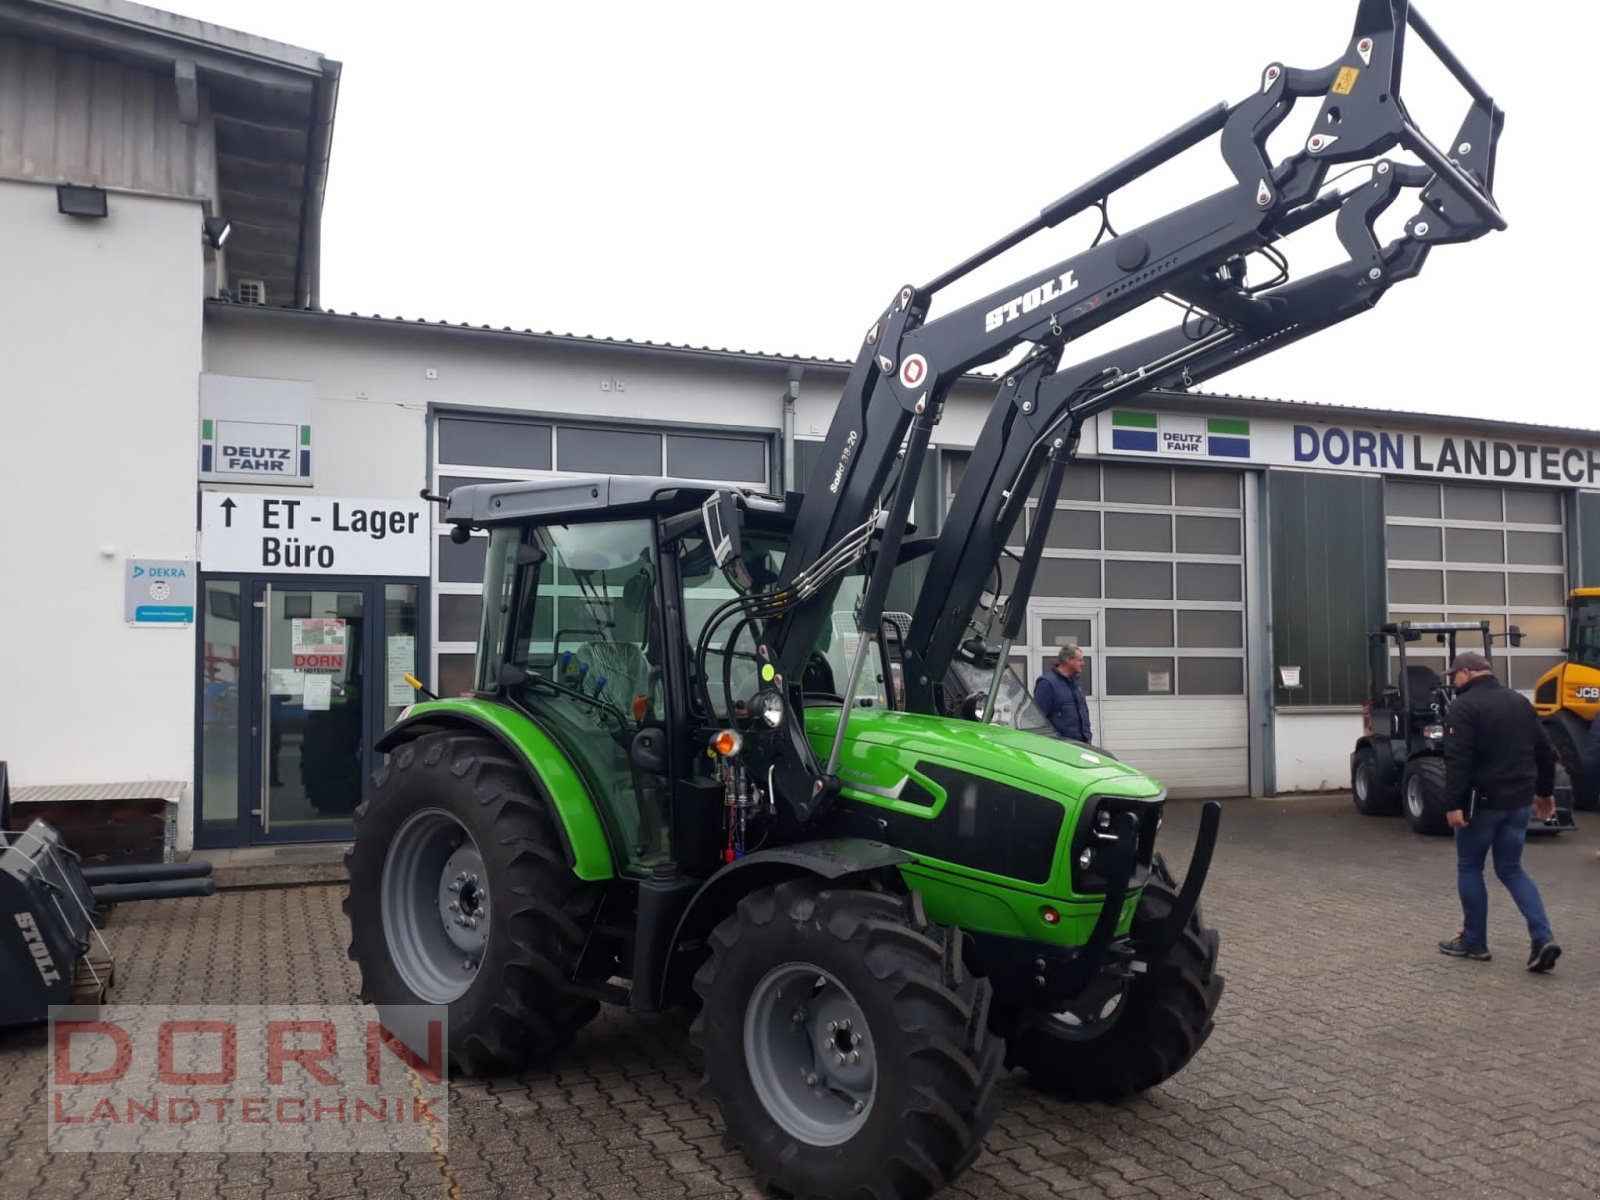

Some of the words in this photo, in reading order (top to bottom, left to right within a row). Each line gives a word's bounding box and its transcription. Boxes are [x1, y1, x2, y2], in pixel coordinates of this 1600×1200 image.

[985, 269, 1079, 333] STOLL
[1163, 432, 1203, 443] DEUTZ
[223, 445, 291, 460] DEUTZ
[1167, 442, 1199, 452] FAHR
[1293, 424, 1404, 469] DORN
[1413, 434, 1600, 483] LANDTECH
[229, 458, 284, 472] FAHR
[263, 499, 301, 530] ET
[332, 502, 420, 540] Lager
[262, 536, 335, 569] Büro
[149, 567, 186, 577] DEKRA
[293, 654, 344, 667] DORN
[1575, 687, 1599, 698] JCB
[13, 911, 62, 987] STOLL
